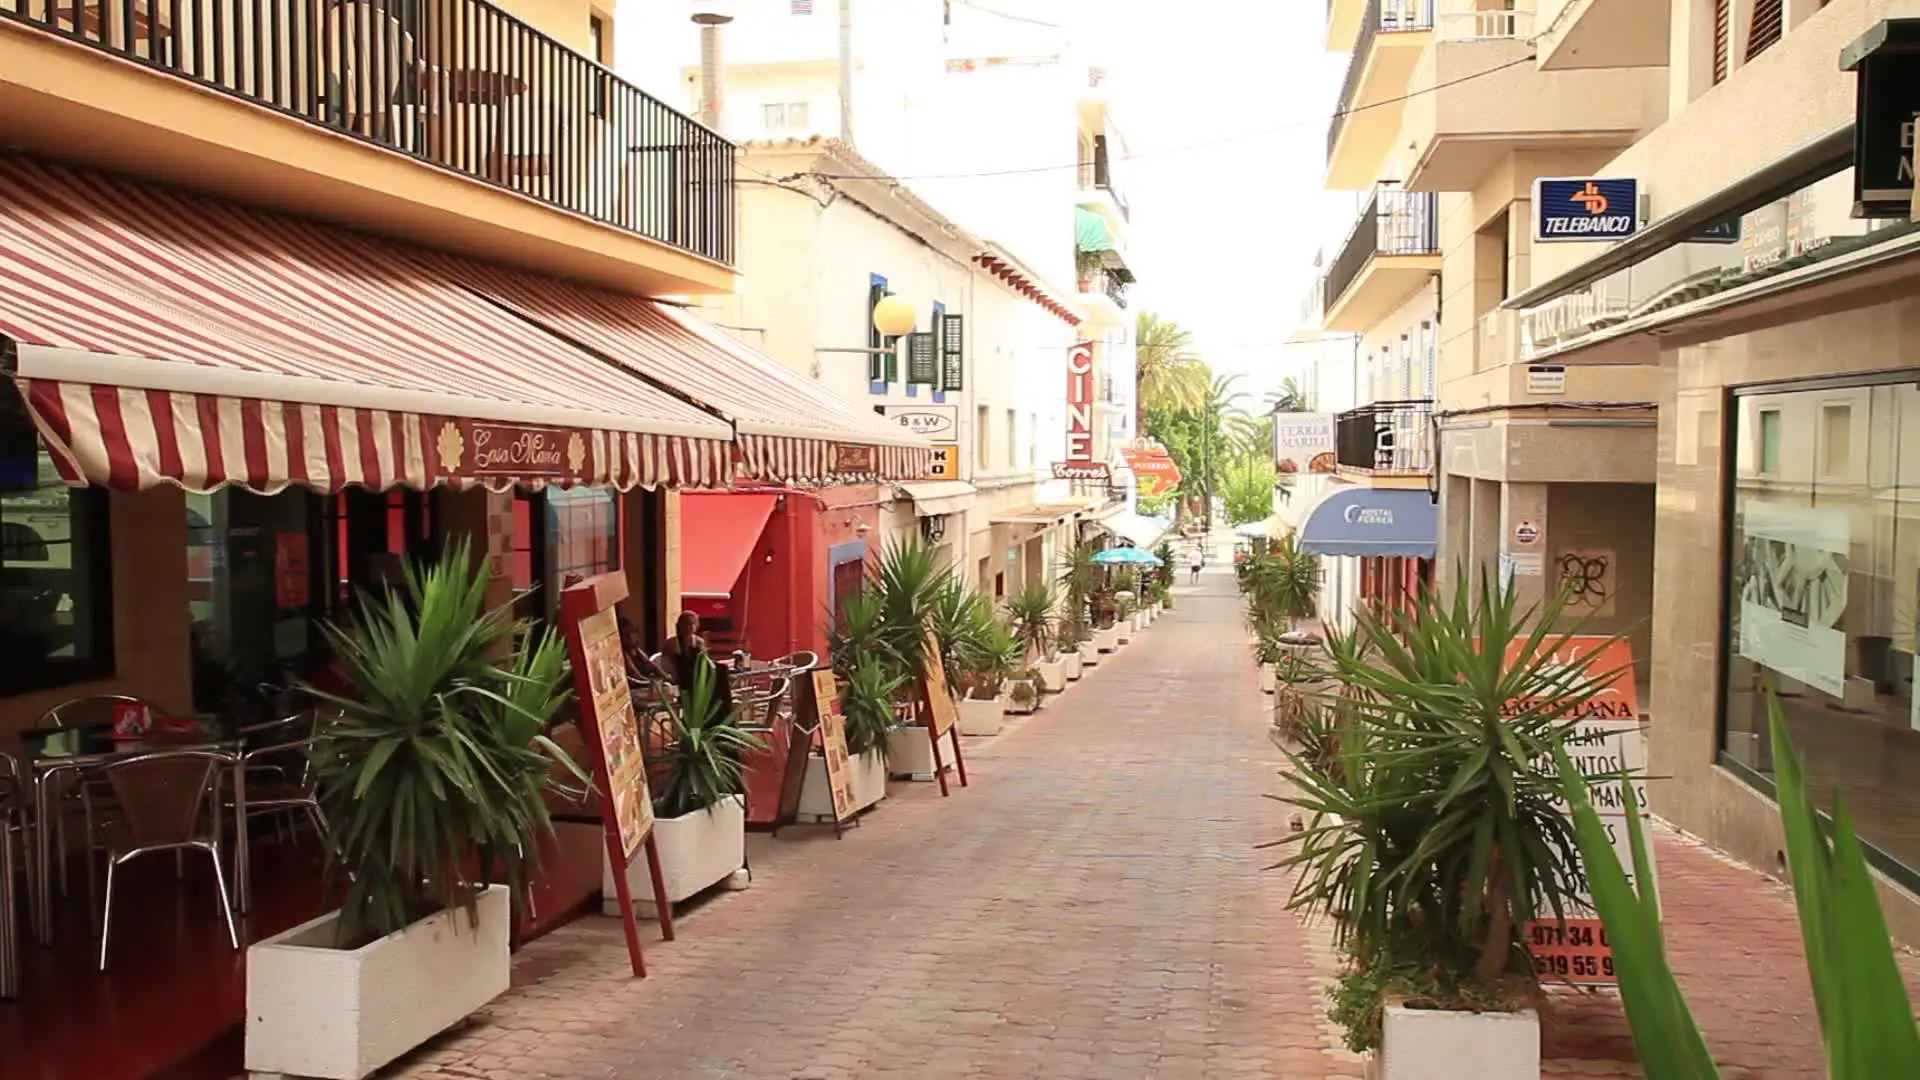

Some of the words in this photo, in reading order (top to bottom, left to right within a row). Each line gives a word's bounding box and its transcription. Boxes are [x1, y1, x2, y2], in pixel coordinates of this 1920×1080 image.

[1546, 216, 1630, 233] TELEBANCO
[1067, 348, 1091, 460] CINE
[473, 429, 509, 467] Casa
[1569, 926, 1594, 947] 34
[1573, 956, 1598, 976] 55
